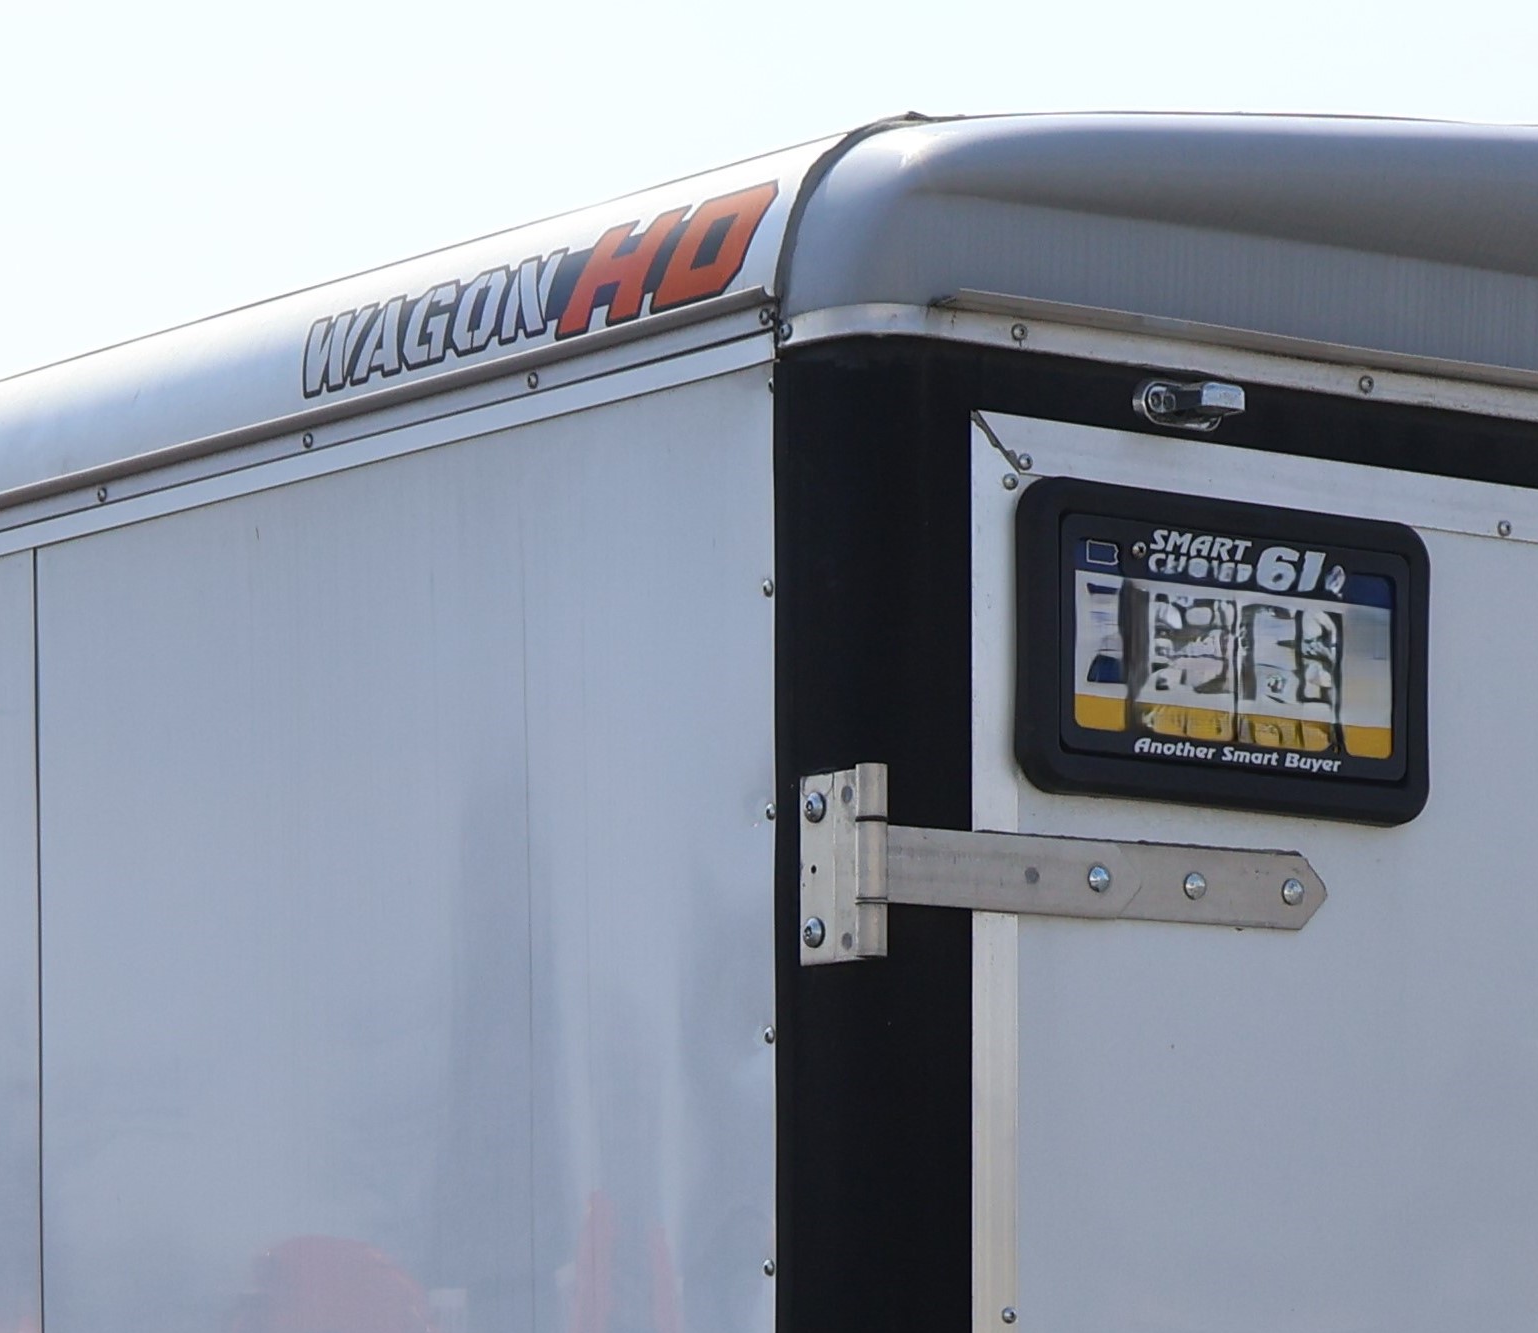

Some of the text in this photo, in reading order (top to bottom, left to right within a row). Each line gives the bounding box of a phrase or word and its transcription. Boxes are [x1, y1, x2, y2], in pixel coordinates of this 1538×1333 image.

[303, 180, 779, 398] WAGON HD
[1151, 529, 1252, 561] SMART
[1133, 737, 1341, 773] Another Smart Buyer
